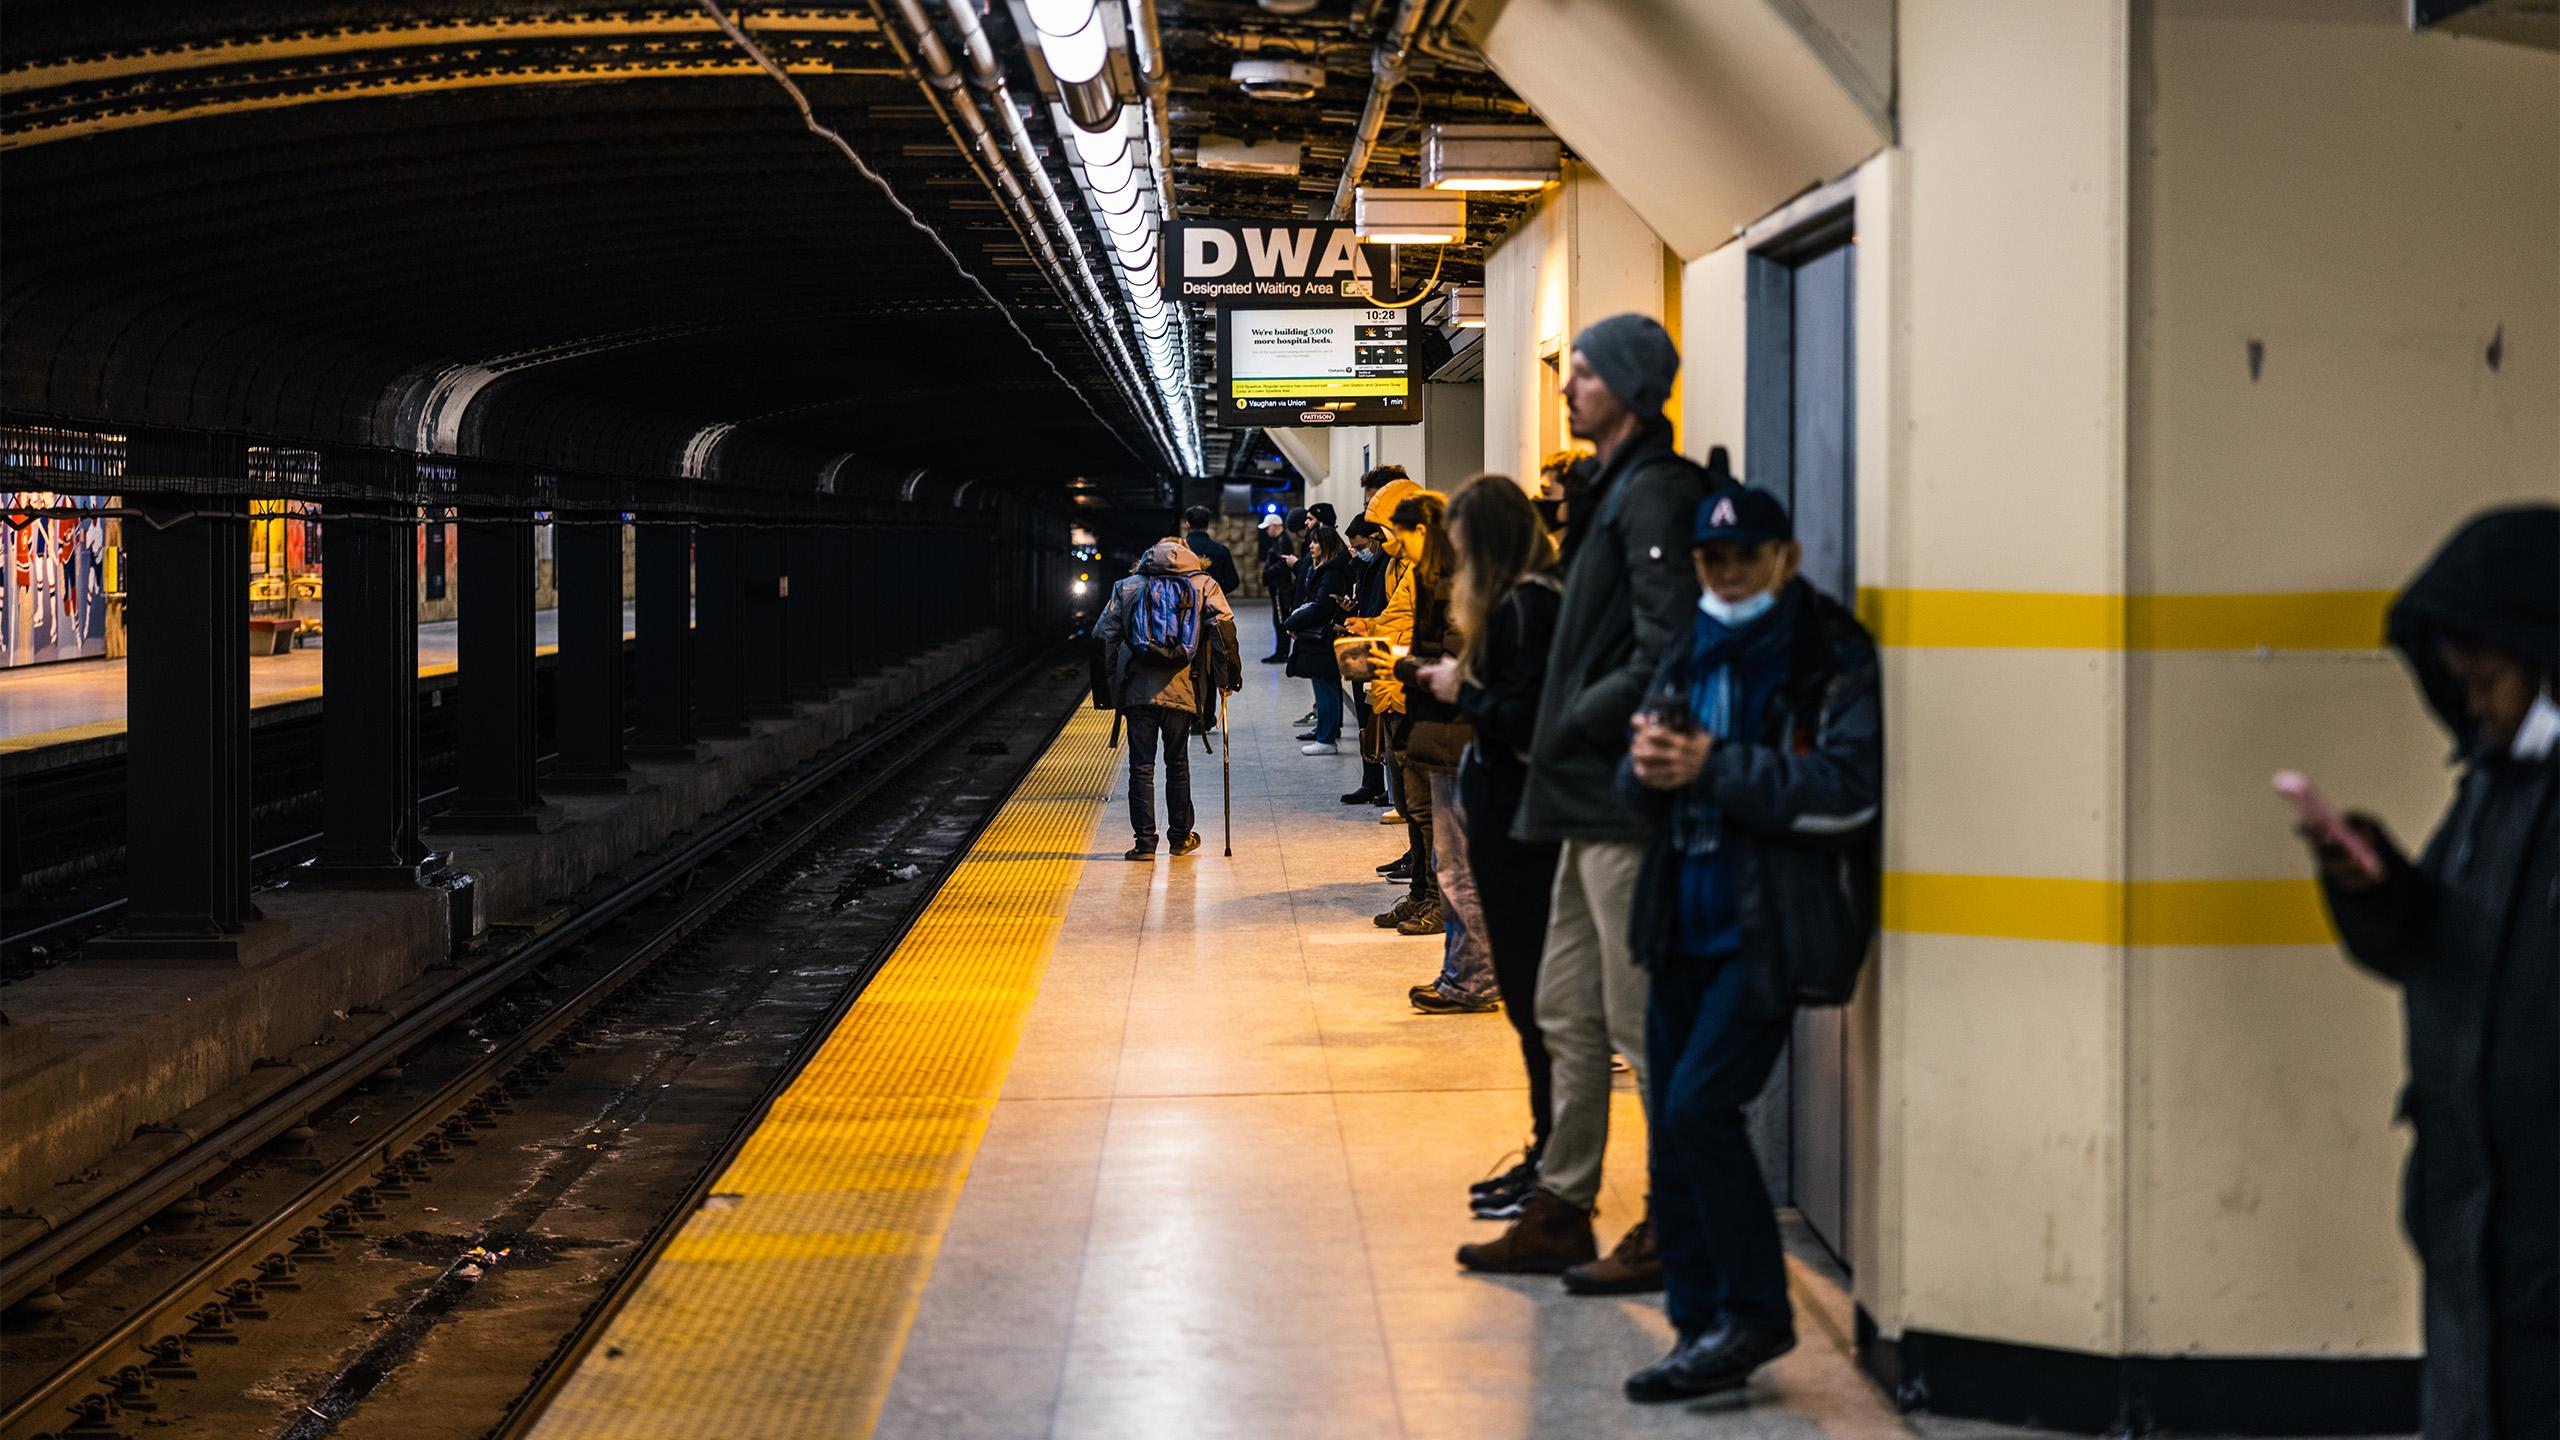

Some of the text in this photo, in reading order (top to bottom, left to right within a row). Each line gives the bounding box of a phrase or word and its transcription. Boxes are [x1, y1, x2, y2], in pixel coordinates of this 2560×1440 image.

[1183, 228, 1373, 277] DWA
[1183, 281, 1334, 296] Designated Waiting Area
[1366, 310, 1395, 320] 10:28
[1274, 328, 1308, 337] building
[1277, 337, 1310, 345] hospital
[1249, 400, 1277, 408] Vaughan
[1383, 398, 1388, 407] 1
[1711, 497, 1737, 527] A
